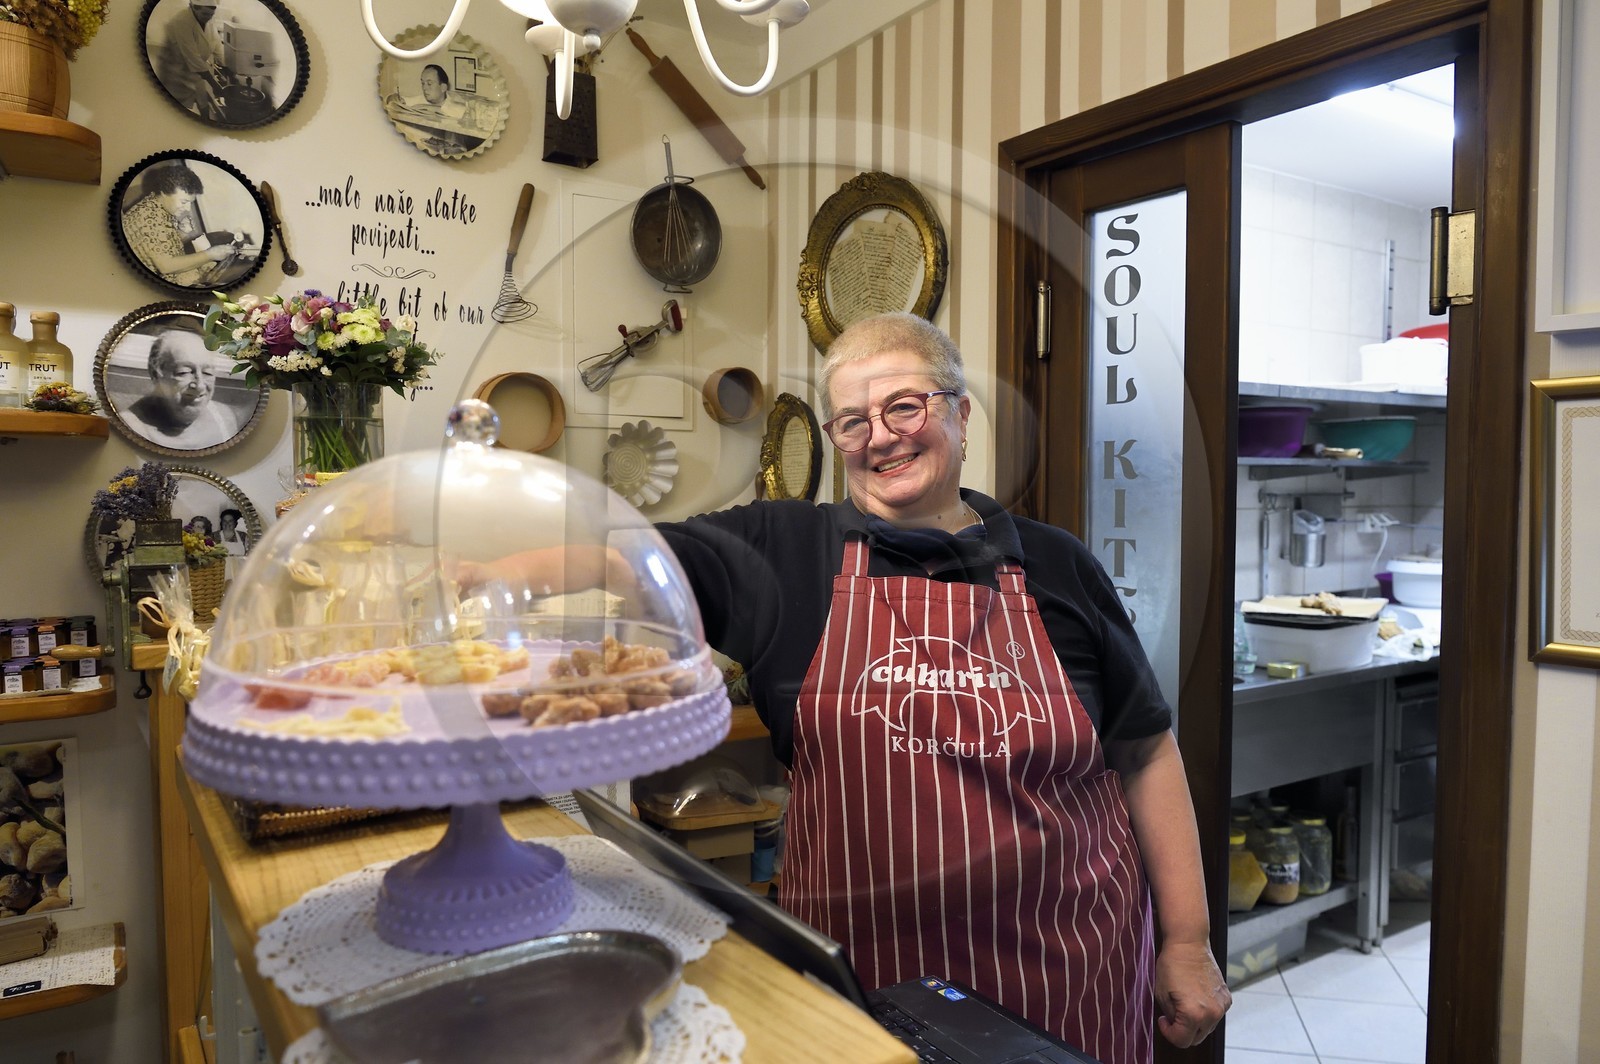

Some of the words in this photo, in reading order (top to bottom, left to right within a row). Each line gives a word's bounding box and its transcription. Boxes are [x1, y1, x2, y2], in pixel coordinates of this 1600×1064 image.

[375, 188, 414, 216] naše
[425, 186, 477, 225] slatke
[399, 286, 421, 318] bit
[459, 303, 485, 325] our
[1103, 213, 1141, 405] SOUL
[29, 363, 57, 372] TRUT
[871, 663, 1012, 689] cukarin
[891, 736, 1012, 758] KORČULA
